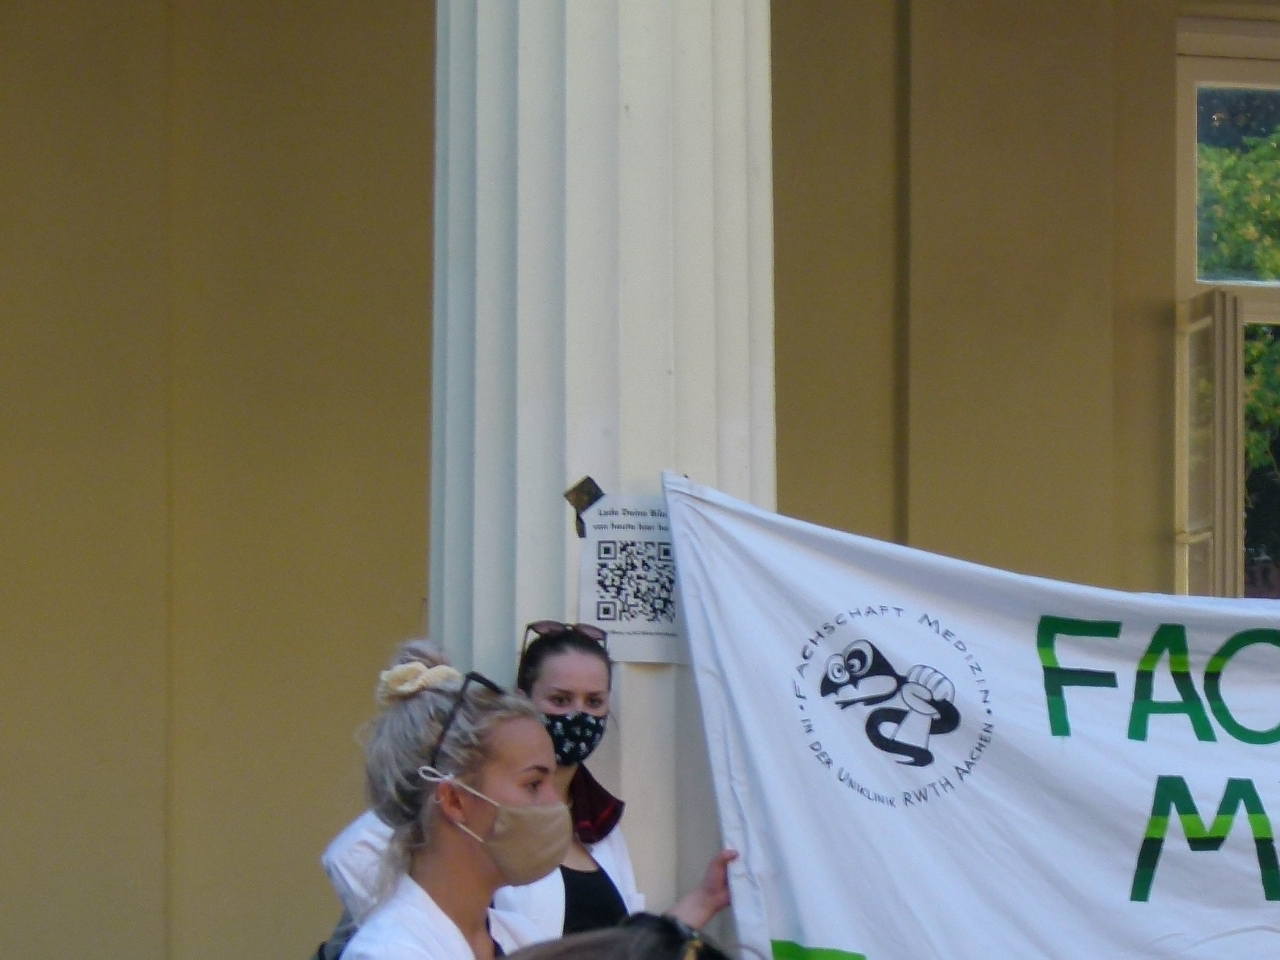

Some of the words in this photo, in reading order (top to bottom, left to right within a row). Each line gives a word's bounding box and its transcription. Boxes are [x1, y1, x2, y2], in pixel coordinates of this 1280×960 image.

[793, 605, 905, 700] FACHSCHAFT
[918, 613, 990, 704] MEDIZIN
[800, 717, 816, 735] IN
[808, 740, 834, 779] DER
[903, 775, 955, 807] RWTH
[953, 722, 995, 781] AACHEN
